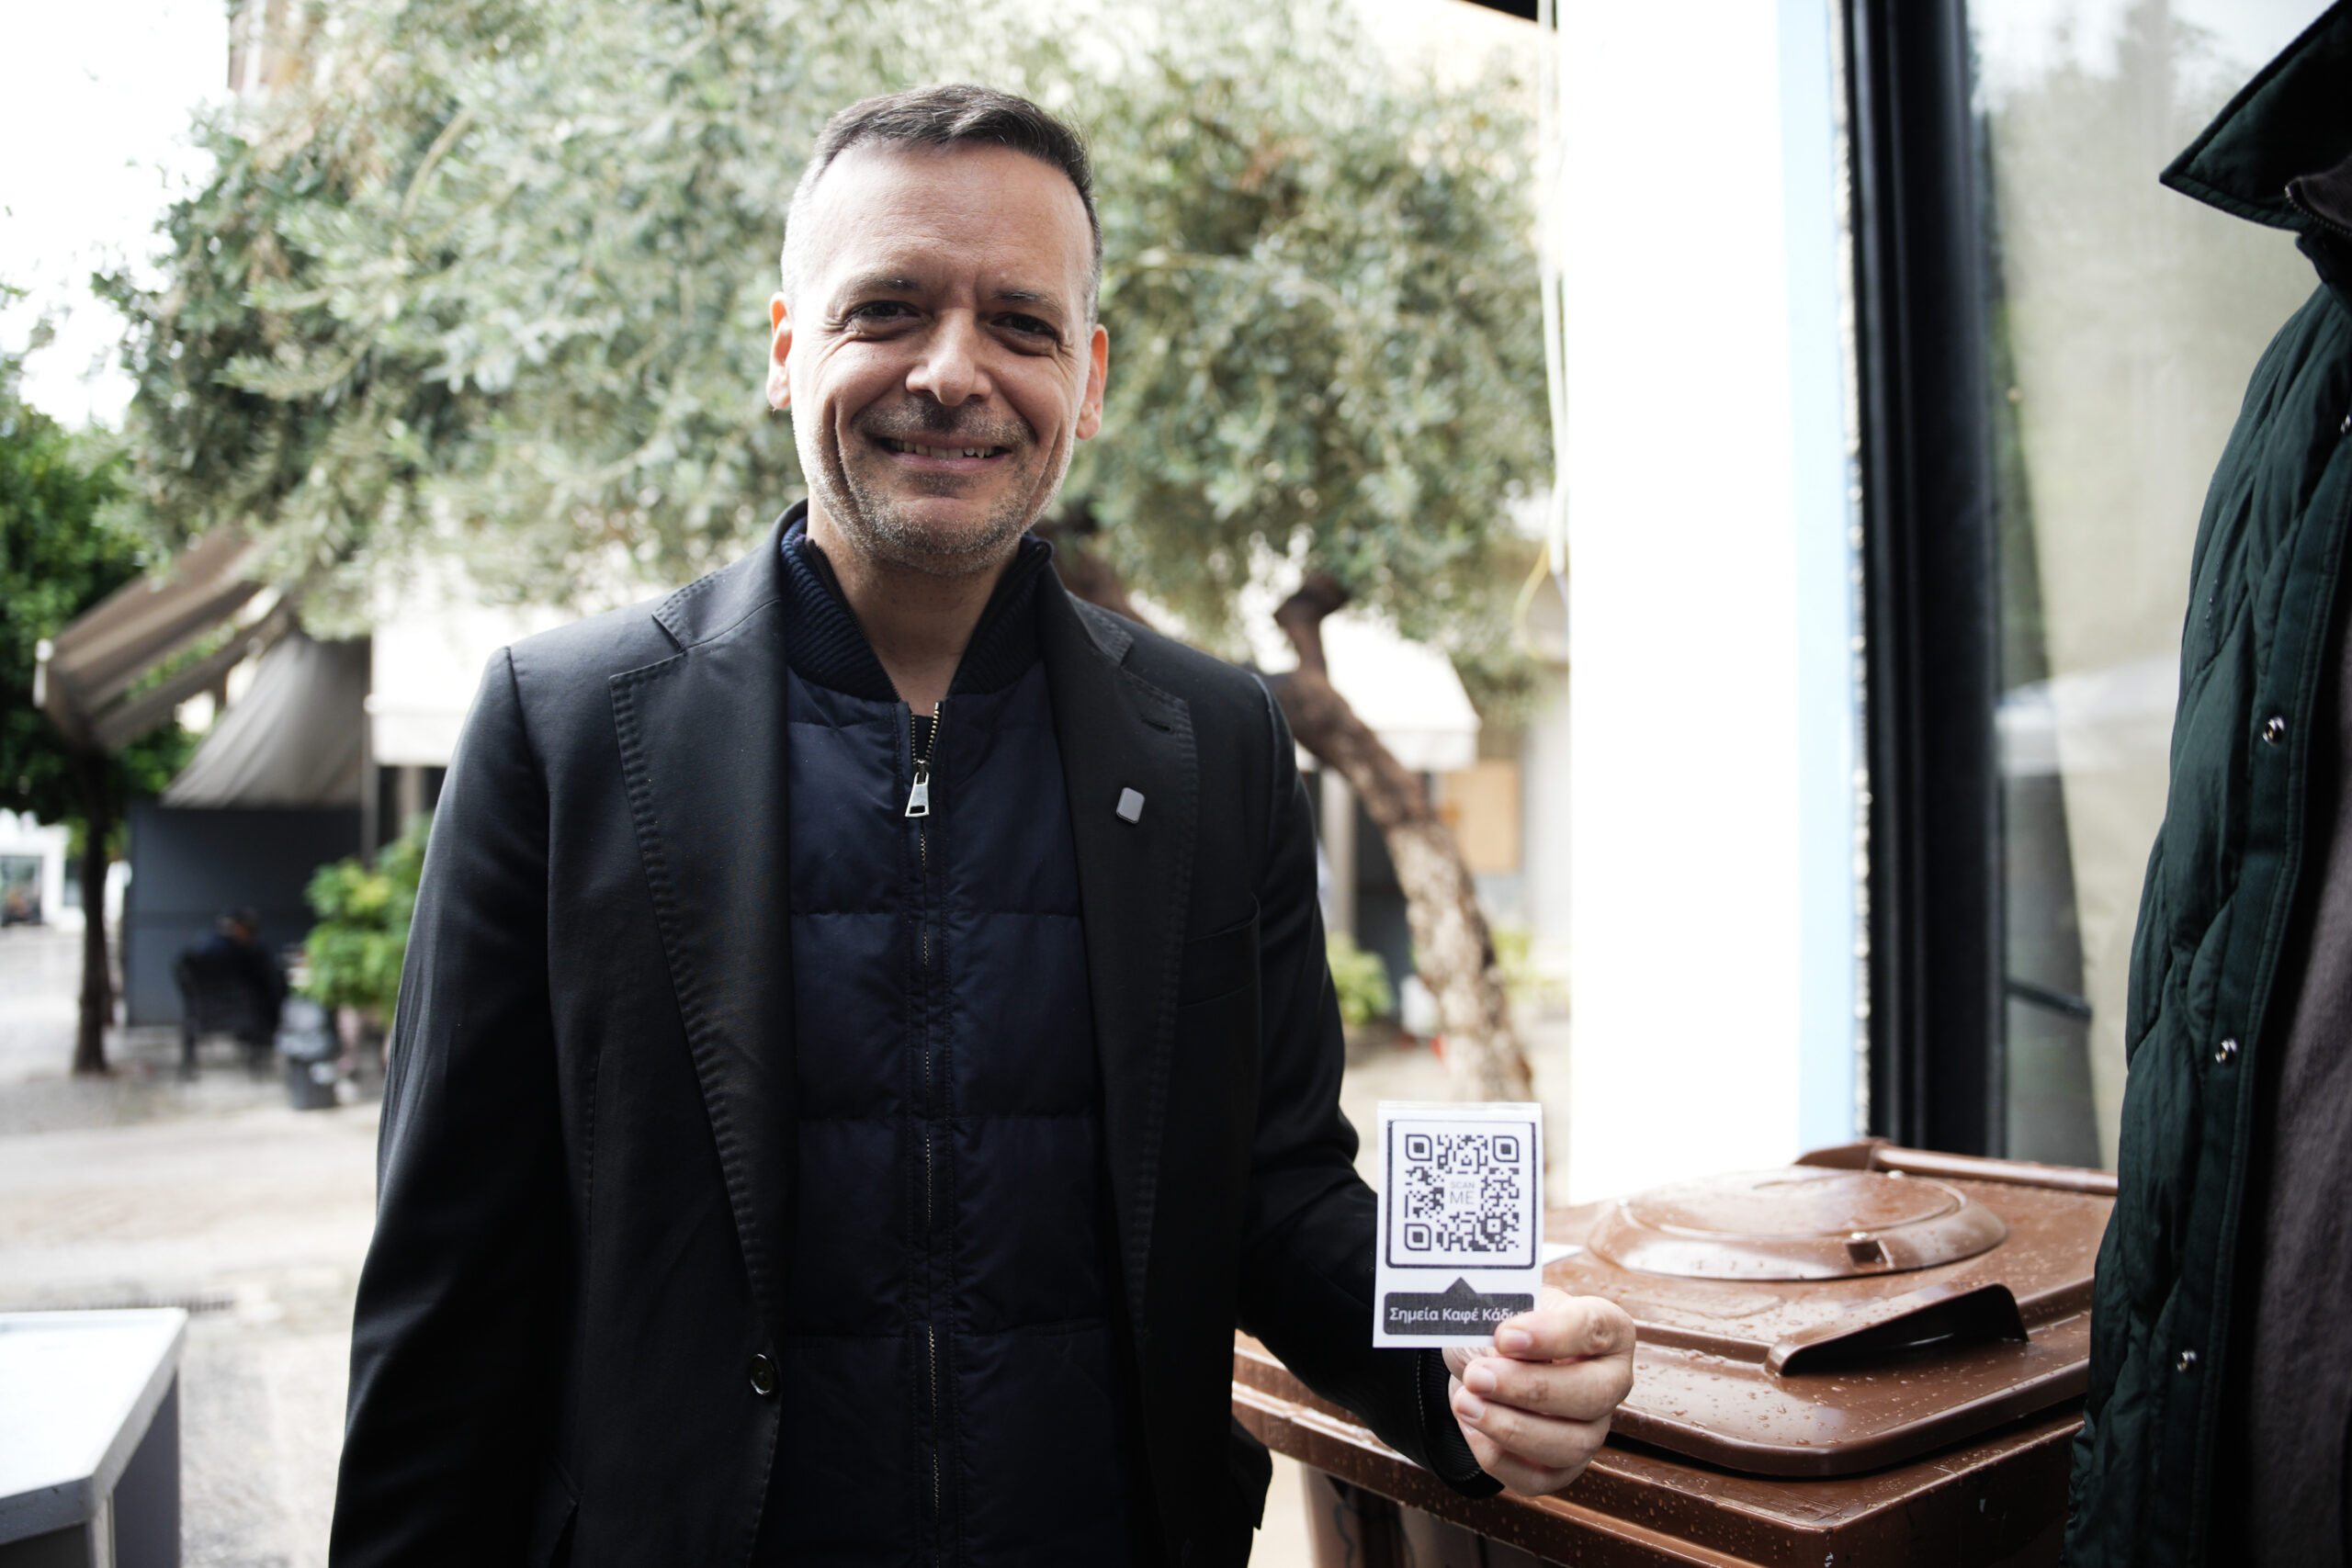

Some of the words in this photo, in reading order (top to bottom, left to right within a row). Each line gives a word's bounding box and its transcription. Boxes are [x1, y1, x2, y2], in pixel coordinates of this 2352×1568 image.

[1451, 1181, 1476, 1190] SCAN
[1450, 1190, 1475, 1204] ME
[1389, 1306, 1440, 1325] Σημεία
[1442, 1307, 1478, 1325] Καφέ
